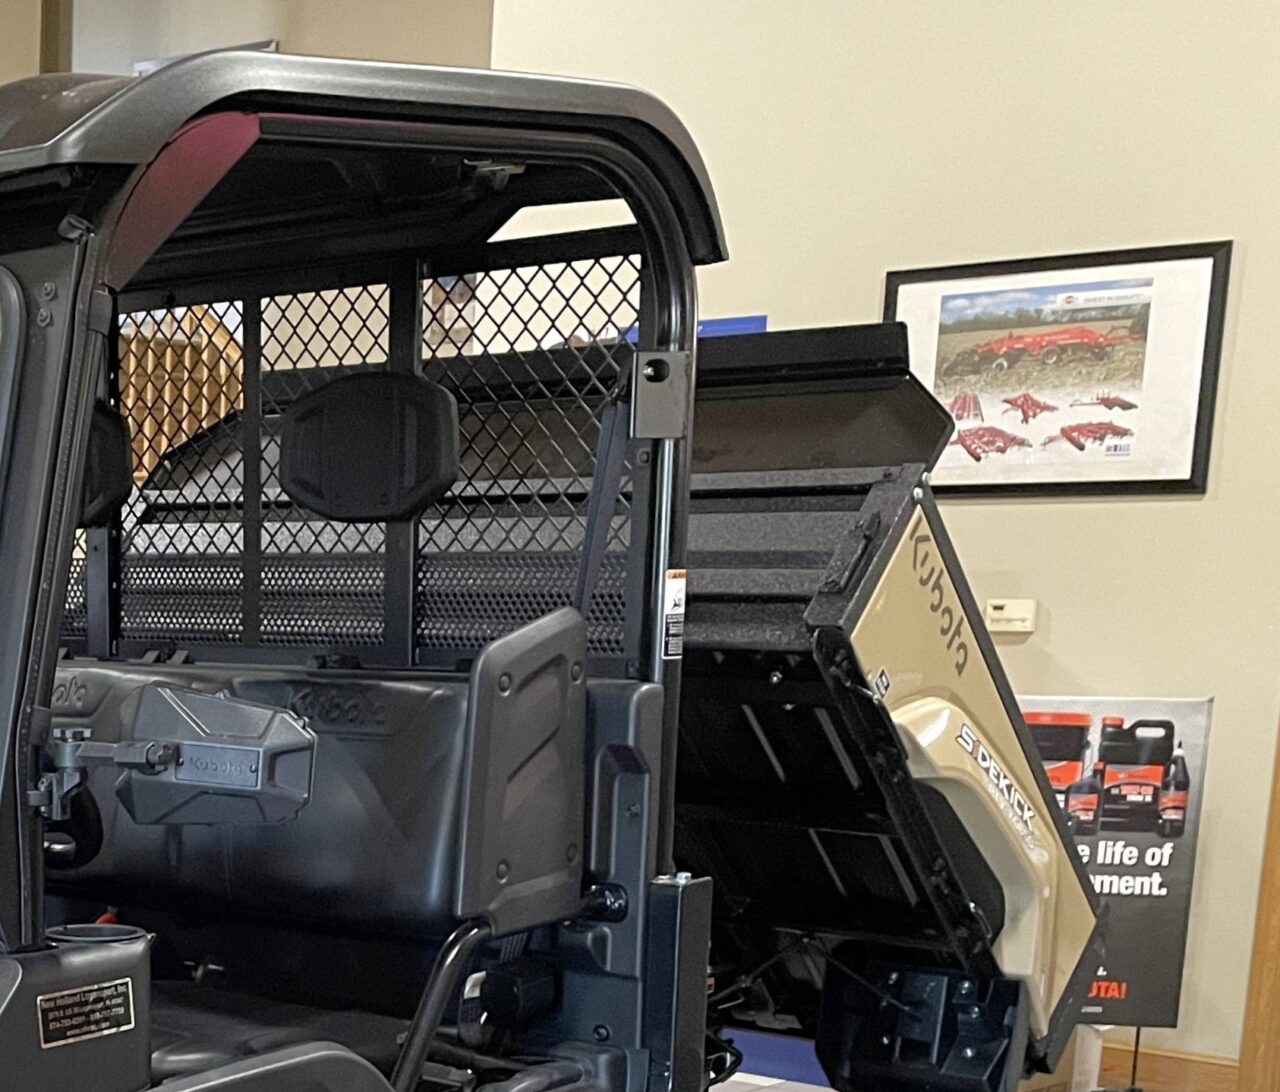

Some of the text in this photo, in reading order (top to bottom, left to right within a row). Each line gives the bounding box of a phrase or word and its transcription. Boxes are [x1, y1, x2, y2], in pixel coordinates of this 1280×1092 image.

[909, 518, 969, 678] Kubota
[190, 756, 243, 775] Kubota
[955, 723, 1036, 833] SIDEKICK
[1096, 840, 1139, 866] life
[1145, 842, 1174, 867] of
[1089, 871, 1168, 896] ment.
